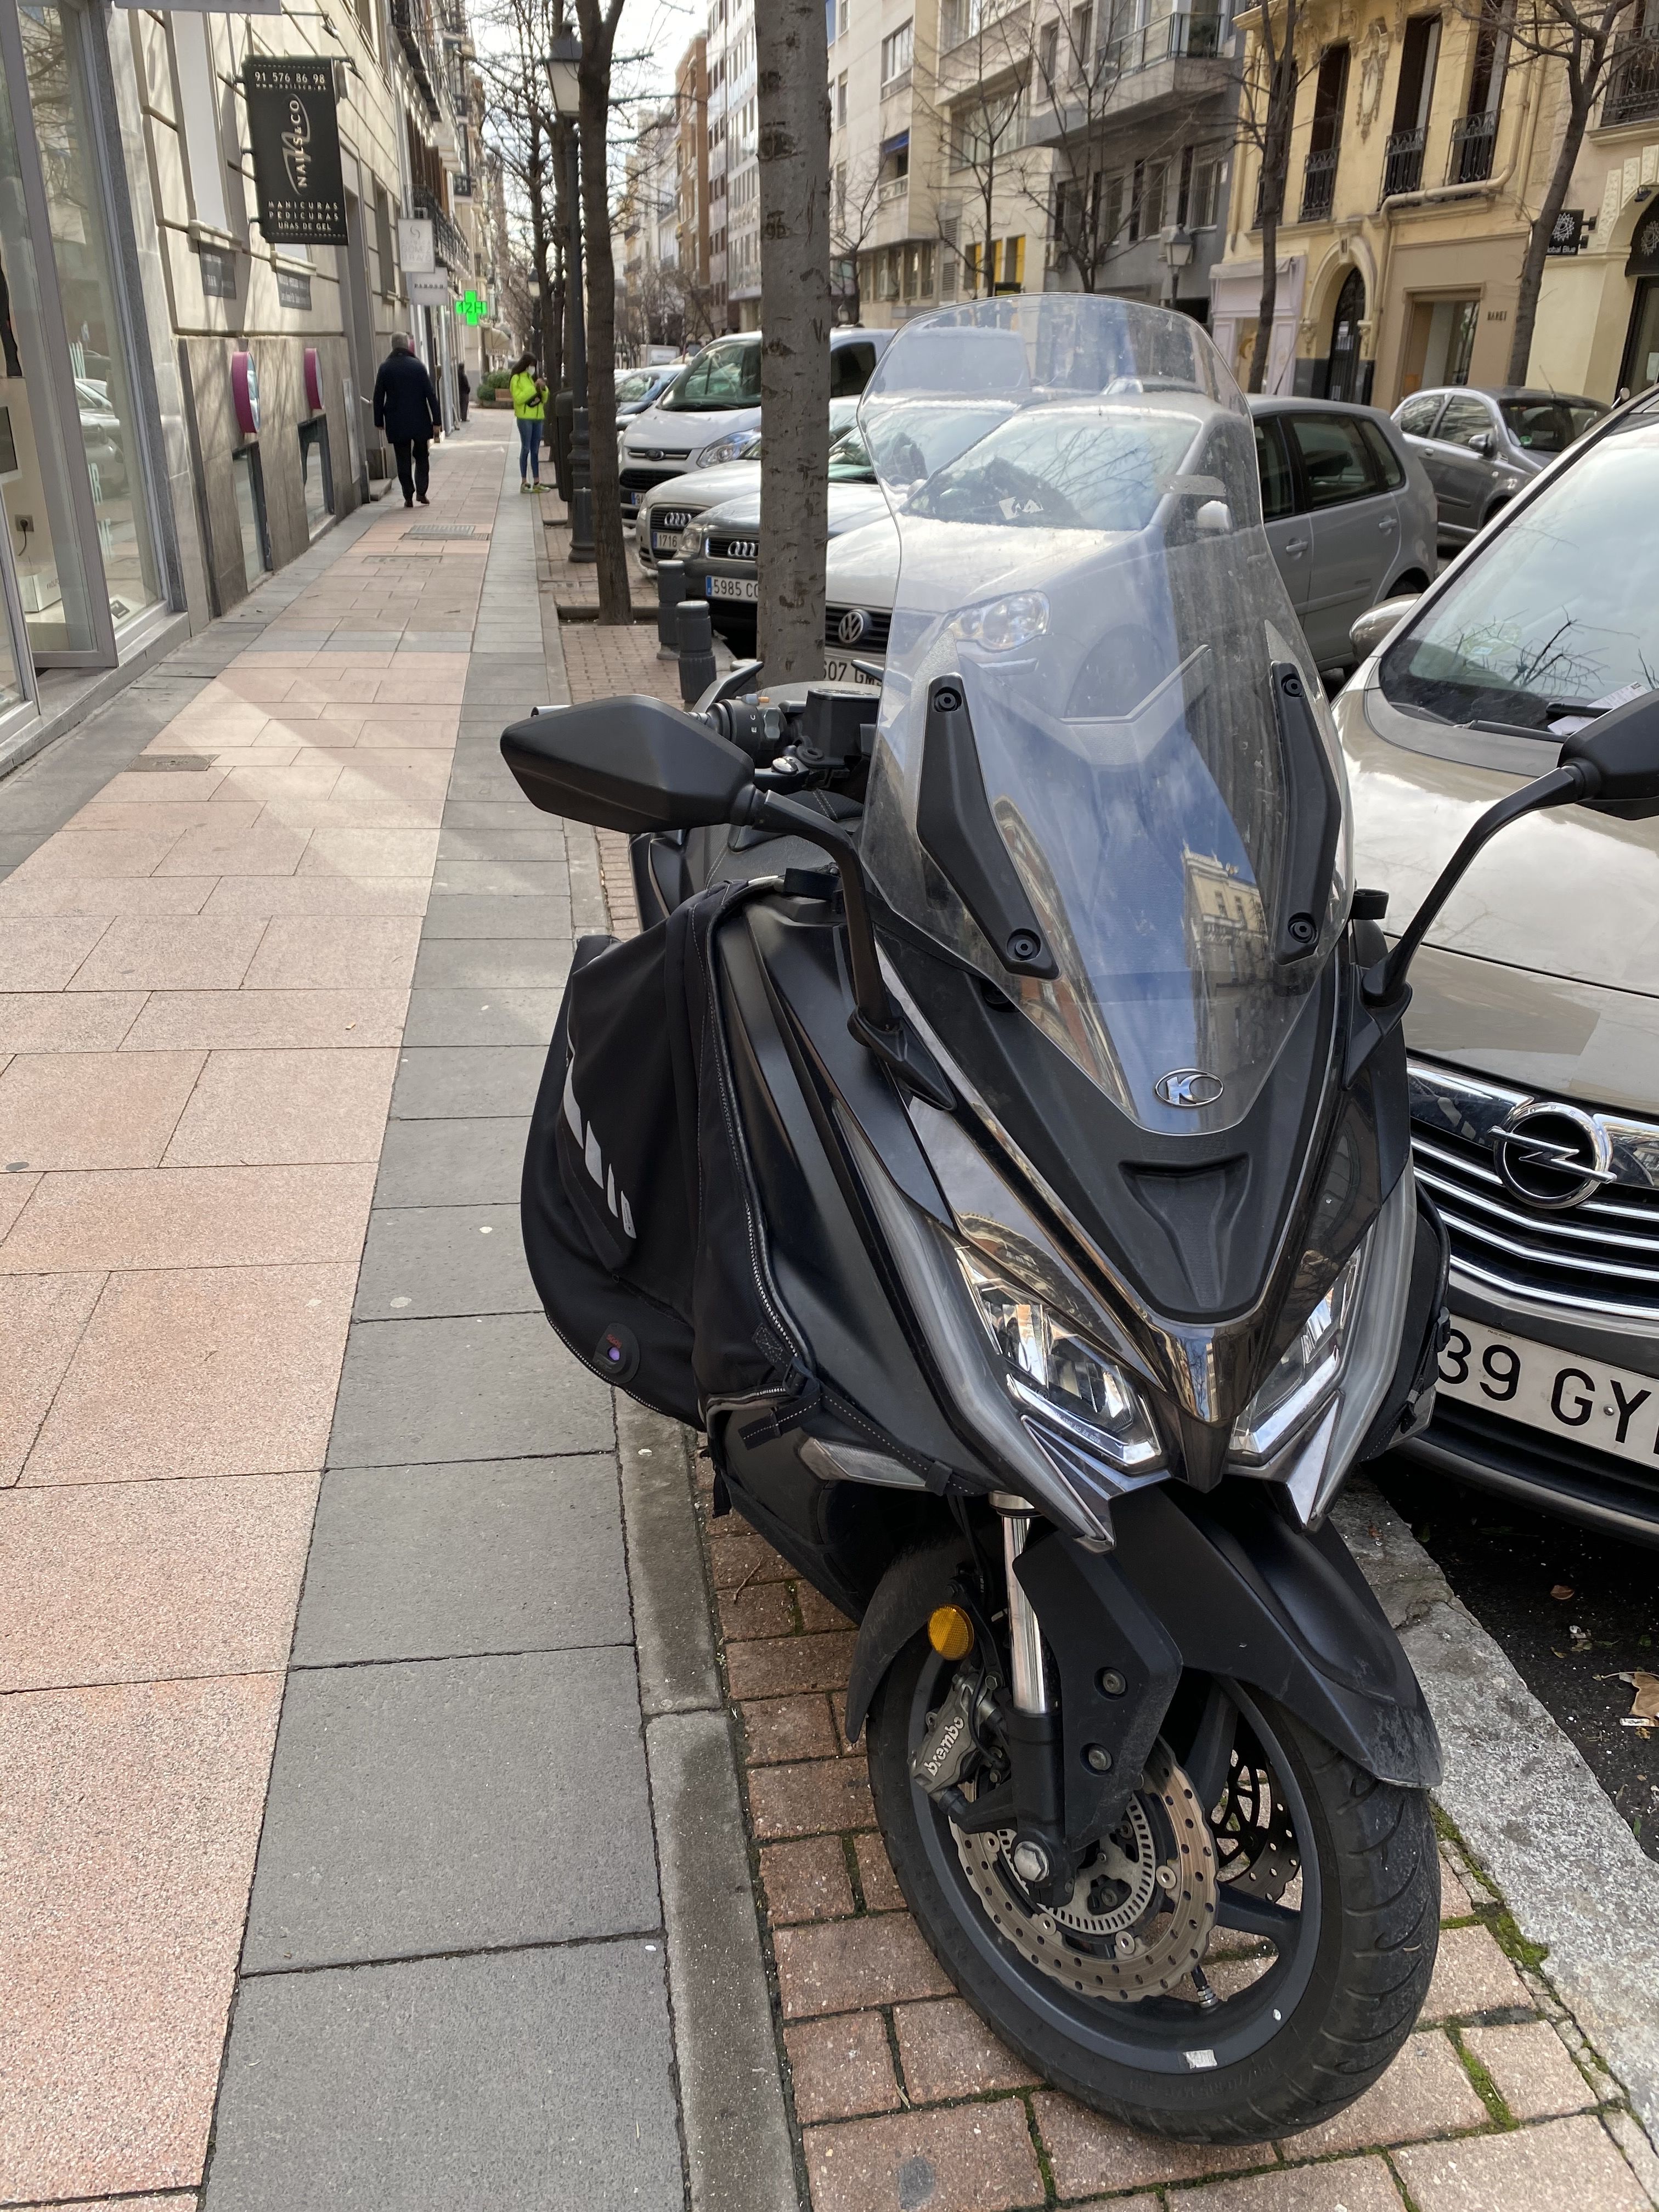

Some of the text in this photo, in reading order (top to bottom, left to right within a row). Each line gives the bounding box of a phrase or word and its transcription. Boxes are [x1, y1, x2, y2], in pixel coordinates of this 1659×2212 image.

[254, 71, 325, 84] 91 576 86 98
[268, 201, 338, 210] MANICURAS
[269, 211, 338, 221] PEDICURAS
[278, 221, 299, 230] UÑAS
[459, 302, 483, 314] 12H
[659, 534, 678, 548] 1716
[714, 579, 741, 596] 5985
[1438, 1328, 1659, 1454] 39 GY
[924, 1716, 964, 1776] brembo
